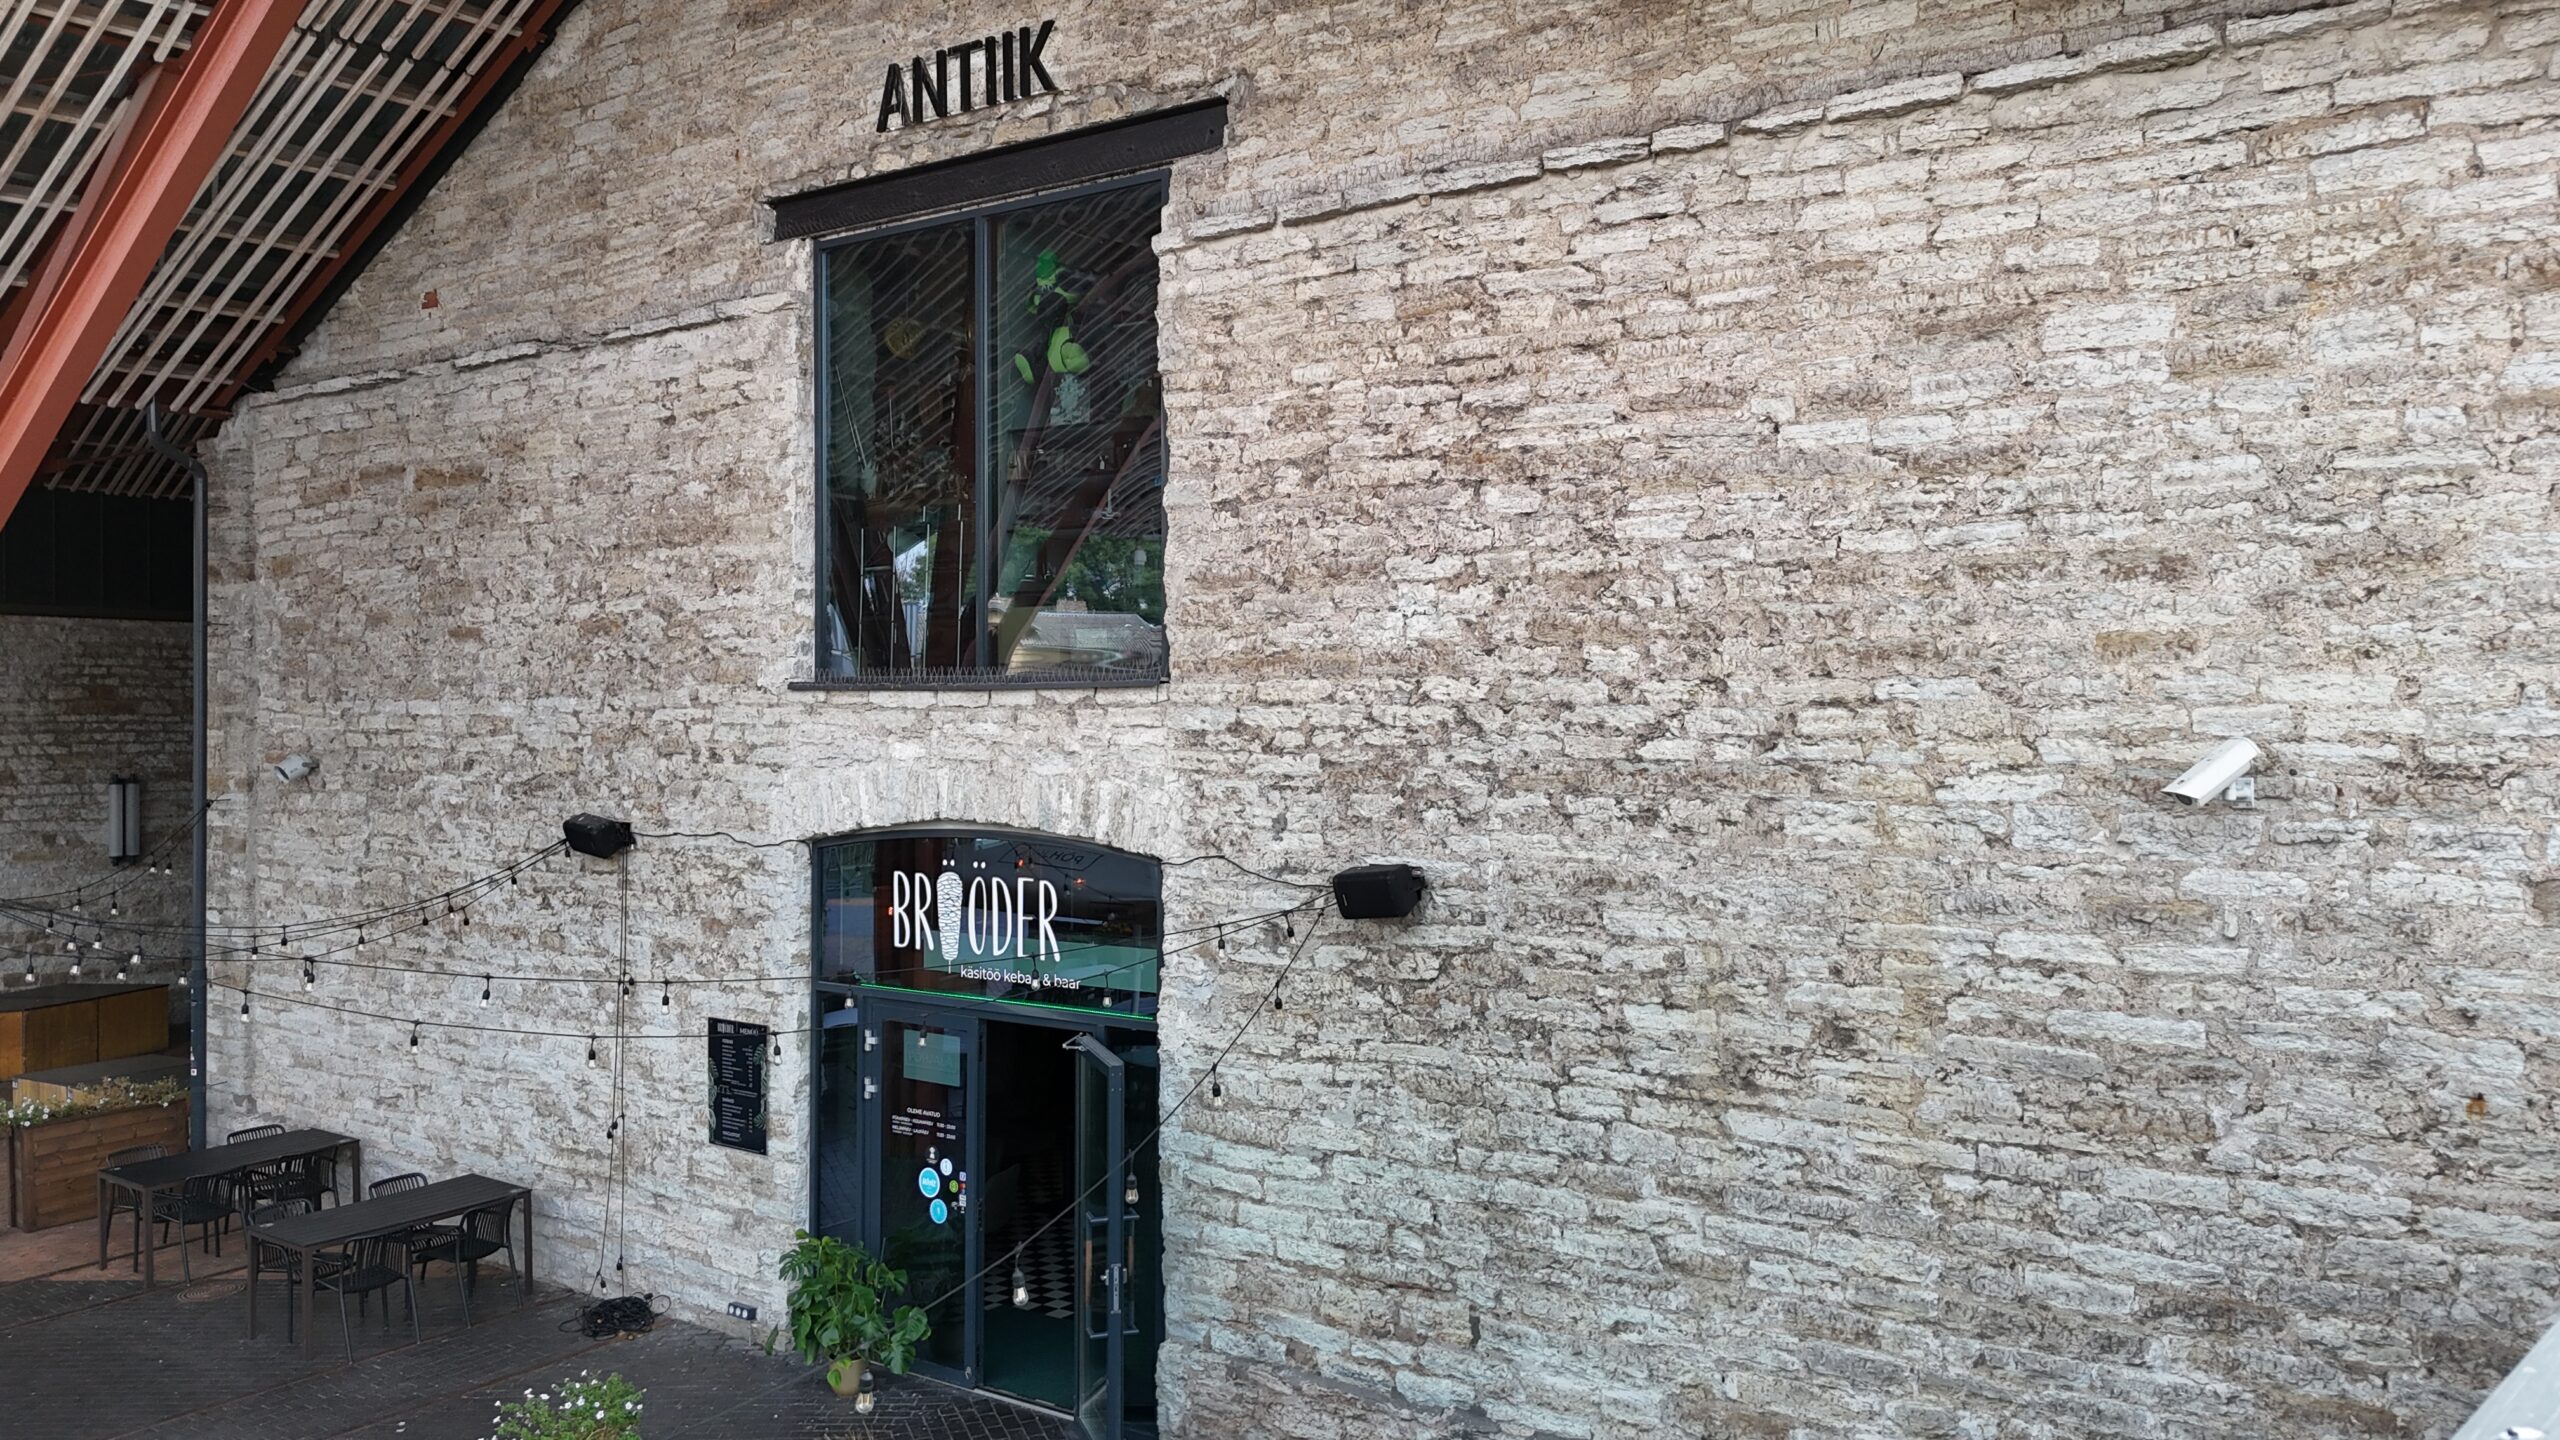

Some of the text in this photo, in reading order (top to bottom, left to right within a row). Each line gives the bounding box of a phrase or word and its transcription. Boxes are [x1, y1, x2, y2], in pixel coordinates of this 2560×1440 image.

[876, 19, 1059, 133] ANTIIK
[1004, 970, 1039, 986] keba
[1044, 974, 1053, 988] &
[1055, 974, 1082, 990] baar
